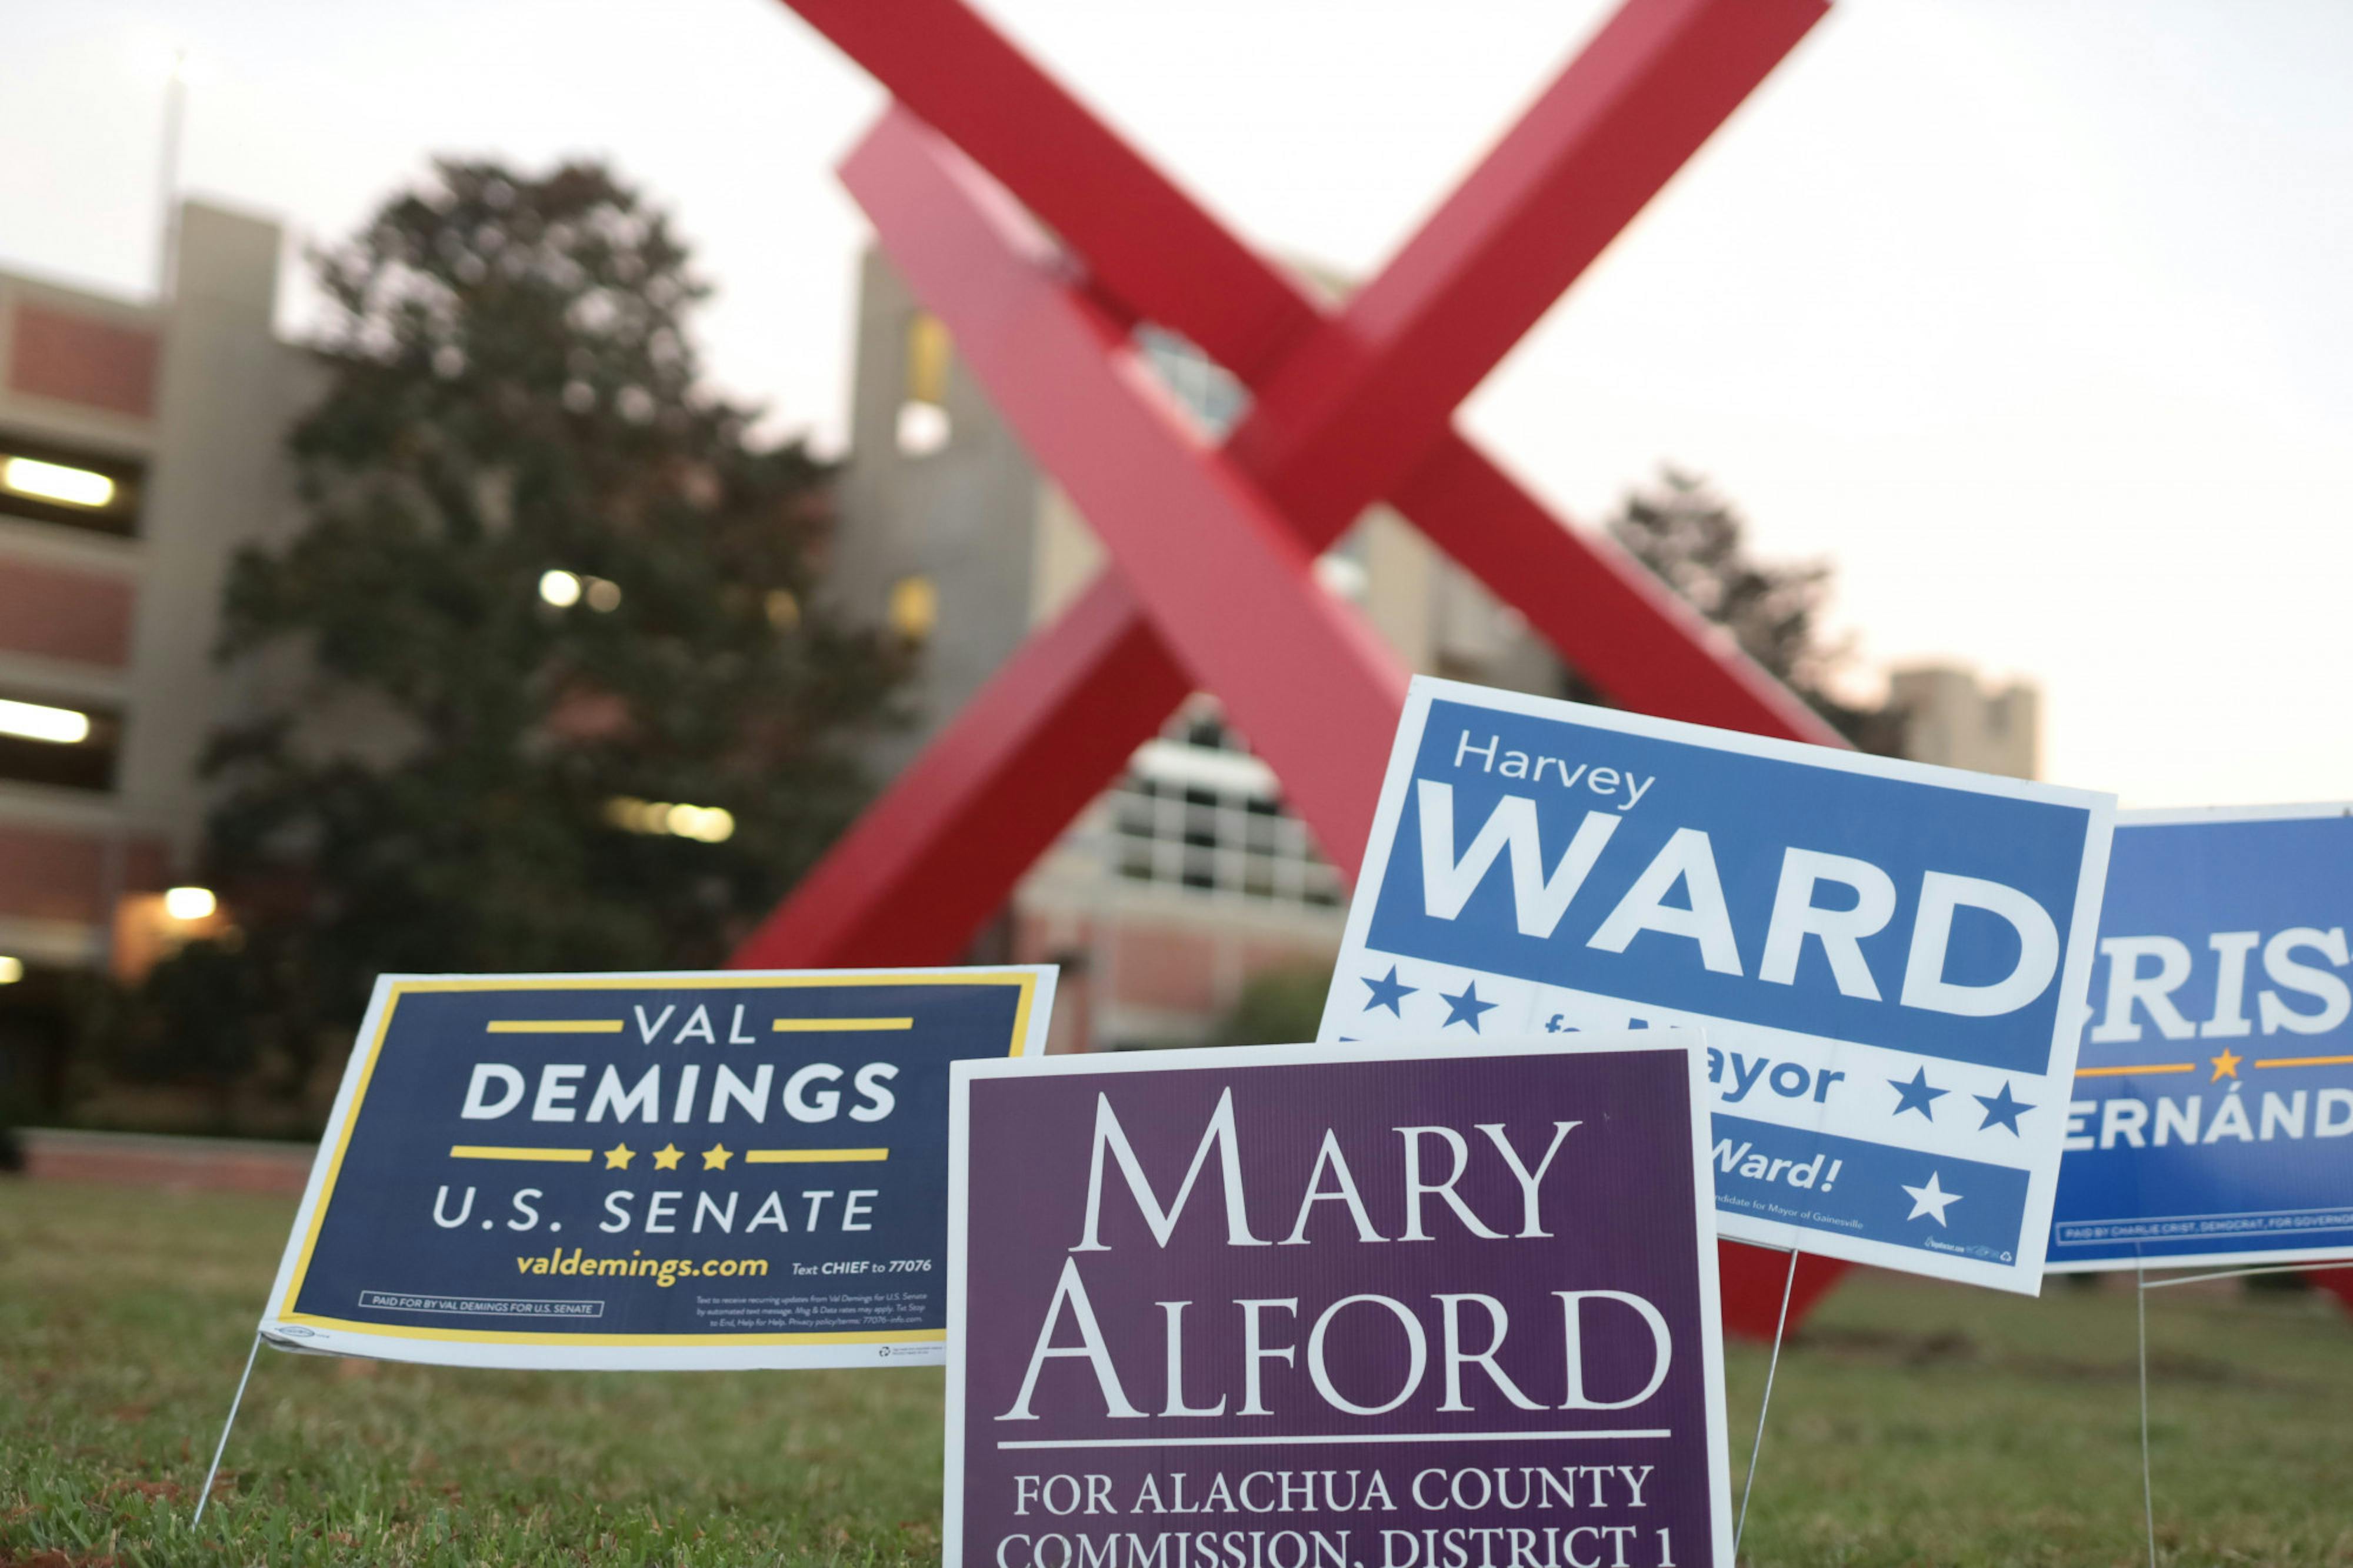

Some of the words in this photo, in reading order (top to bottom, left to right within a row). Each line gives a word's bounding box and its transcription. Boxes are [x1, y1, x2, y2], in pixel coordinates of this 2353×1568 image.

[1454, 729, 1656, 810] Harvey
[1417, 778, 2059, 1017] WARD
[2084, 927, 2353, 1043] RIS
[633, 1003, 756, 1045] VAL
[460, 1062, 899, 1124] DEMINGS
[1706, 1046, 1845, 1103] ayor
[1067, 1085, 1584, 1253] MARY
[1711, 1137, 1843, 1193] Ward!
[432, 1185, 562, 1233] U.S.
[598, 1189, 879, 1234] SENATE
[1752, 1200, 1766, 1210] for
[1768, 1203, 1798, 1217] Mayor
[1801, 1210, 1811, 1219] of
[1812, 1212, 1864, 1230] Gainesville
[516, 1247, 769, 1288] valdemings.com
[792, 1262, 818, 1276] Text
[821, 1260, 870, 1275] CHIEF
[872, 1263, 886, 1273] to
[888, 1259, 932, 1273] 77076
[372, 1295, 399, 1307] PAID
[399, 1298, 422, 1308] FOR
[424, 1299, 439, 1309] BY
[439, 1300, 459, 1310] VAL
[460, 1301, 509, 1313] DEMINGS
[511, 1303, 534, 1313] FOR
[534, 1304, 552, 1313] U.S.
[553, 1304, 593, 1315] SENATE
[993, 1255, 1672, 1422] ALFORD
[1014, 1473, 1118, 1516] FOR
[1129, 1469, 1398, 1514] ALACHUA
[1411, 1464, 1655, 1511] COUNTY
[996, 1530, 1365, 1568] COMMISSION,
[1379, 1525, 1637, 1568] DISTRICT
[1655, 1527, 1677, 1568] 1
